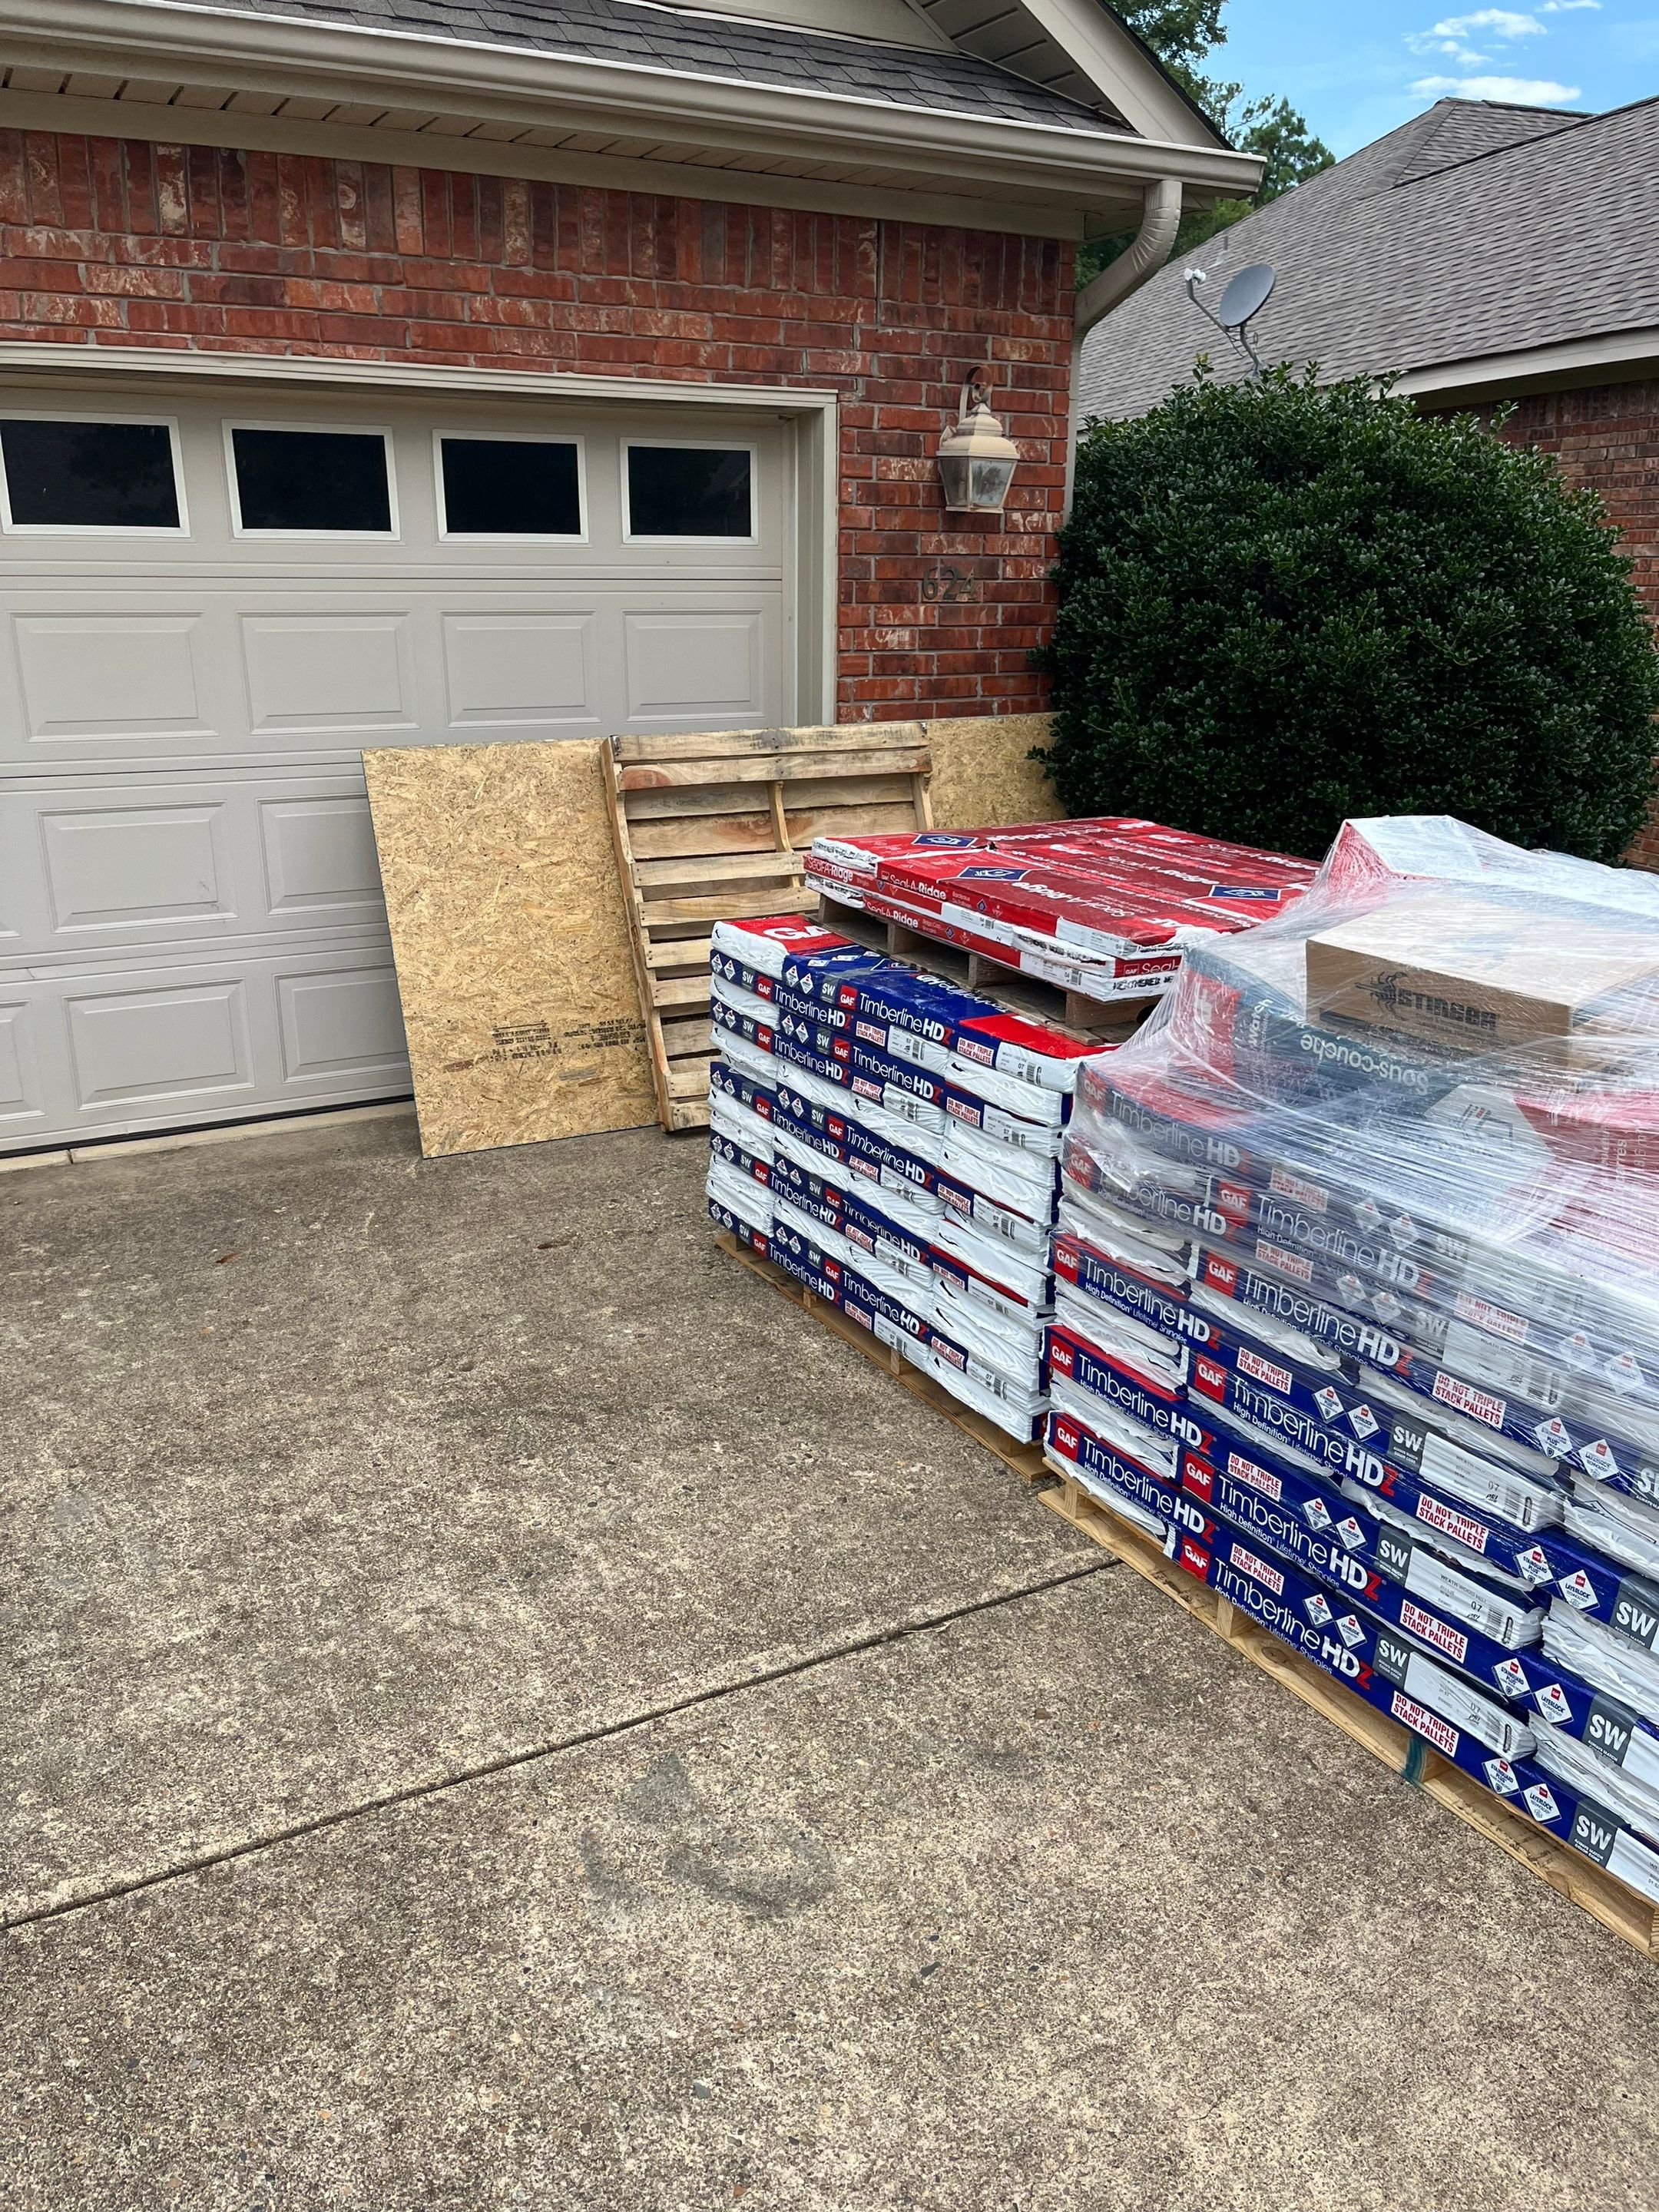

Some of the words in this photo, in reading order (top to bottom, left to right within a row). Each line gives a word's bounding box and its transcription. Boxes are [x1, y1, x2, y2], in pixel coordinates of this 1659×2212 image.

[889, 874, 946, 900] Seal-A-Ridge
[867, 902, 919, 929] Seal-A-Ridge
[763, 926, 833, 940] GA
[742, 971, 753, 985] SW
[757, 983, 771, 995] GAF
[822, 982, 836, 996] SW
[840, 995, 855, 1006] GAF
[743, 1022, 753, 1034] SW
[758, 1032, 771, 1045] GAF
[816, 1033, 829, 1048] SW
[834, 1046, 849, 1058] GAF
[978, 1046, 992, 1057] TRIPLE
[959, 1045, 973, 1055] STACK
[973, 1051, 992, 1063] PALLETS
[1300, 1033, 1429, 1096] Sous-couche
[741, 1090, 752, 1104] SW
[757, 1103, 769, 1115] GAF
[812, 1109, 823, 1124] SW
[829, 1124, 843, 1136] GAF
[755, 1168, 767, 1180] GAF
[809, 1181, 821, 1195] SW
[1220, 1190, 1247, 1207] GAF
[753, 1239, 766, 1251] GAF
[1259, 1242, 1268, 1253] DO
[1270, 1247, 1283, 1259] NOT
[1286, 1253, 1310, 1270] TRIPLE
[809, 1250, 820, 1264] SW
[1057, 1249, 1078, 1267] GAF
[1258, 1250, 1279, 1267] STACK
[1280, 1259, 1309, 1280] PALLETS
[826, 1267, 839, 1280] GAF
[1208, 1261, 1235, 1283] GAF
[1085, 1282, 1100, 1296] High
[1101, 1290, 1130, 1313] Definition
[1051, 1345, 1071, 1366] GAF
[1240, 1350, 1250, 1362] DO
[1251, 1356, 1264, 1369] NOT
[1267, 1363, 1290, 1382] TRIPLE
[1197, 1363, 1223, 1386] GAF
[1240, 1359, 1260, 1377] STACK
[1260, 1369, 1288, 1392] PALLETS
[1435, 1385, 1463, 1406] STACK
[1462, 1398, 1500, 1426] PALLETS
[1438, 1375, 1451, 1389] DO
[1452, 1381, 1470, 1398] NOT
[1472, 1390, 1502, 1413] TRIPLE
[1233, 1401, 1250, 1419] High
[1252, 1412, 1288, 1445] Definition
[1057, 1428, 1078, 1449] GAF
[1393, 1426, 1422, 1452] SW
[1084, 1462, 1098, 1476] High
[1099, 1471, 1128, 1497] Definition
[1186, 1462, 1212, 1485] GAF
[1230, 1464, 1250, 1482] STACK
[1250, 1475, 1278, 1498] PALLETS
[1231, 1455, 1240, 1467] DO
[1241, 1461, 1254, 1475] NOT
[1257, 1469, 1279, 1489] TRIPLE
[1488, 1481, 1499, 1492] 07
[1220, 1502, 1237, 1519] High
[1238, 1514, 1273, 1543] Definition
[1419, 1507, 1446, 1530] STACK
[1445, 1522, 1483, 1550] PALLETS
[1422, 1497, 1434, 1512] DO
[1435, 1505, 1452, 1522] NOT
[1455, 1516, 1485, 1540] TRIPLE
[1184, 1545, 1207, 1568] GAF
[1233, 1546, 1243, 1558] DO
[1244, 1553, 1257, 1568] NOT
[1259, 1563, 1281, 1584] TRIPLE
[1379, 1540, 1408, 1568] SW
[1232, 1554, 1253, 1574] STACK
[1253, 1568, 1280, 1593] PALLETS
[1471, 1601, 1482, 1611] 07
[1404, 1603, 1416, 1618] DO
[1417, 1611, 1433, 1629] NOT
[1436, 1622, 1465, 1648] TRIPLE
[1616, 1601, 1656, 1637] SW
[1402, 1613, 1428, 1637] STACK
[1428, 1628, 1462, 1659] PALLETS
[1379, 1640, 1407, 1667] SW
[1394, 1703, 1419, 1728] STACK
[1419, 1720, 1454, 1753] PALLETS
[1396, 1694, 1407, 1708] DO
[1409, 1703, 1425, 1721] NOT
[1427, 1716, 1455, 1743] TRIPLE
[1589, 1714, 1628, 1751] SW
[1576, 1815, 1612, 1851] SW
